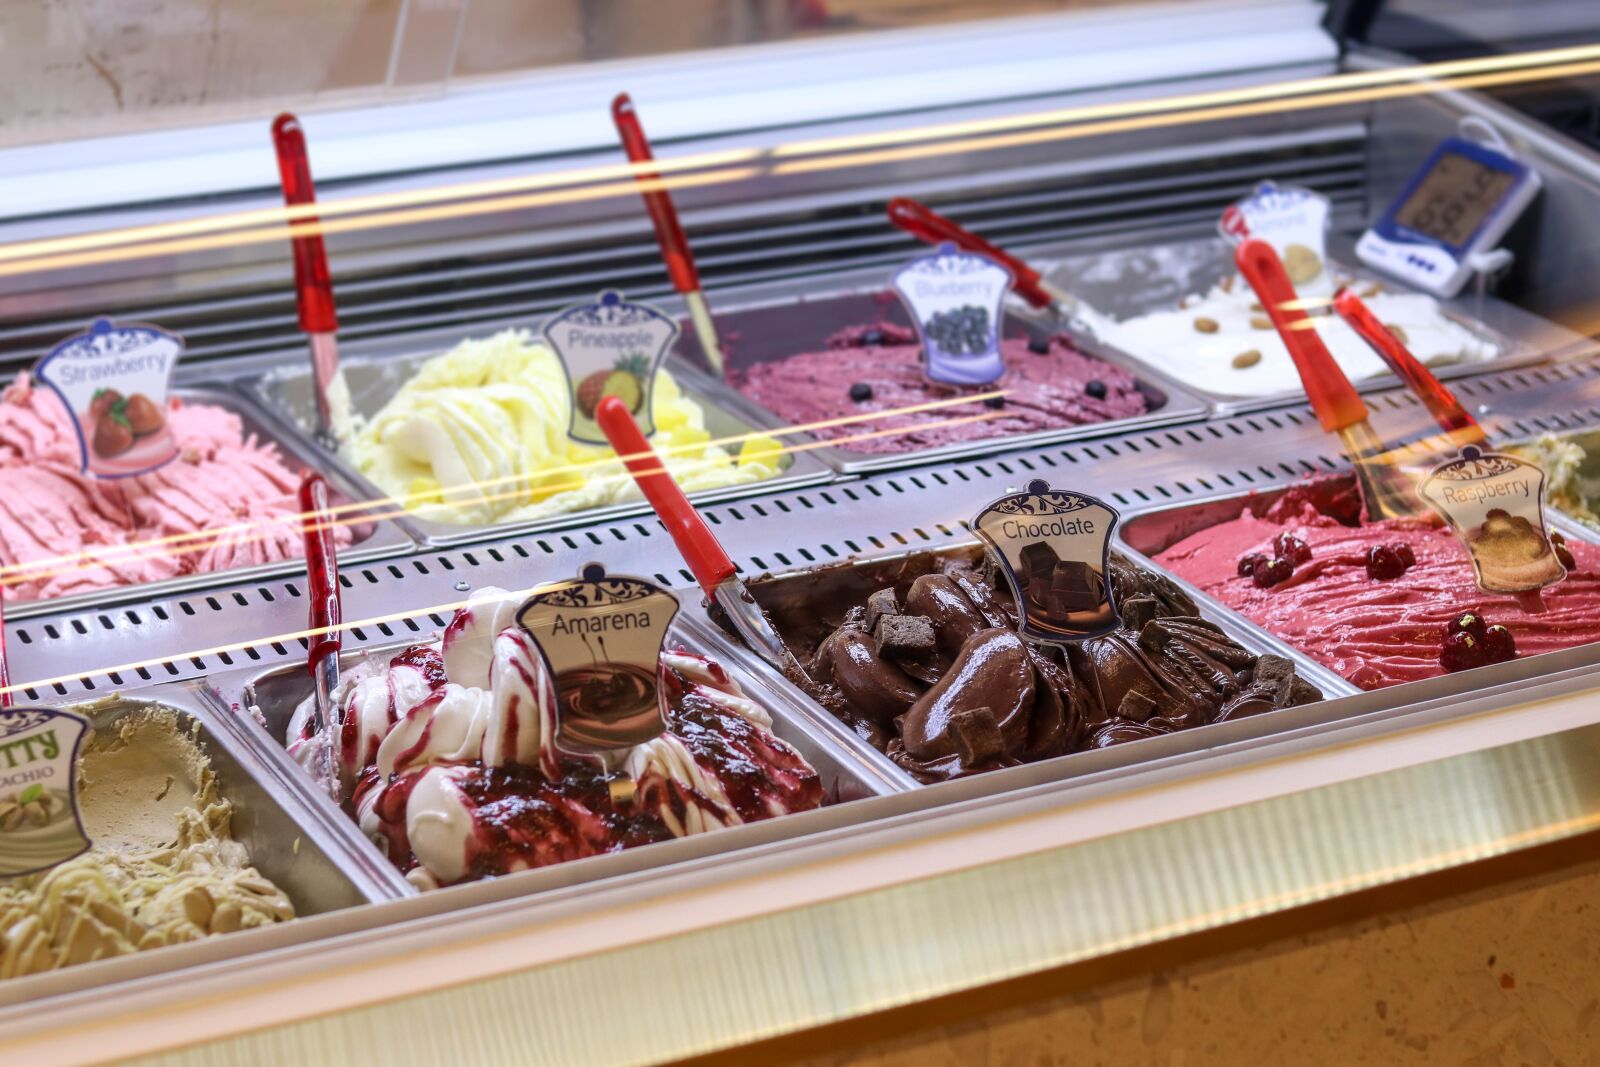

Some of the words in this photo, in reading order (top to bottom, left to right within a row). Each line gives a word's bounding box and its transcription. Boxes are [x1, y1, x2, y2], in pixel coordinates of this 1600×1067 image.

[567, 329, 654, 353] Pineapple
[60, 353, 167, 385] Strawberry
[1442, 479, 1530, 505] Raspberry
[1002, 517, 1095, 539] Chocolate
[551, 611, 651, 636] Amarena
